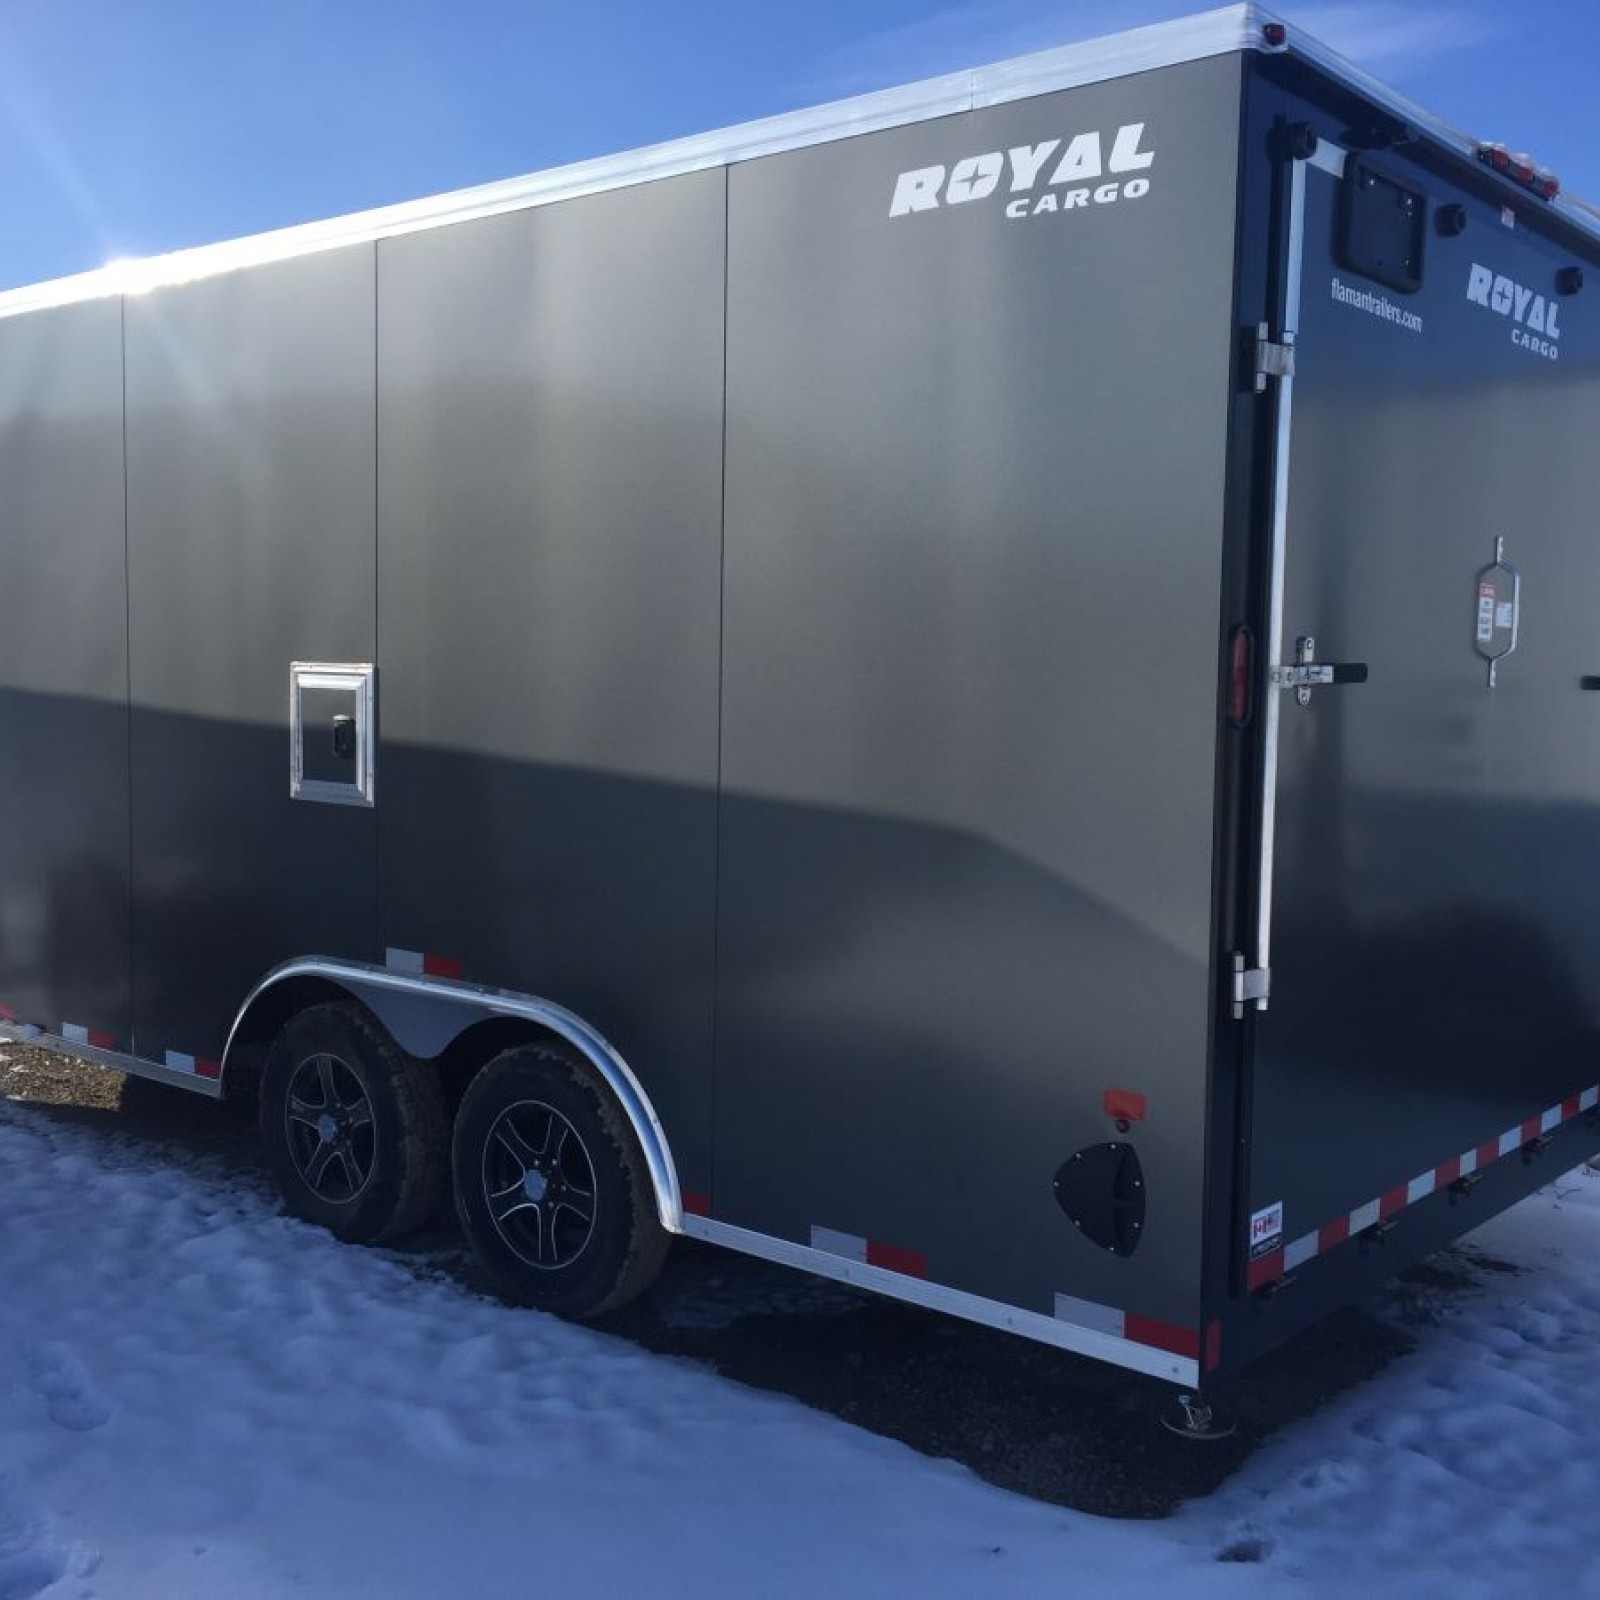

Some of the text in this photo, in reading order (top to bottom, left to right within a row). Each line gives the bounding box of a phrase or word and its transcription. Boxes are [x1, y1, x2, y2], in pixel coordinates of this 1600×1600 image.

[888, 122, 1155, 218] ROYAL
[1006, 178, 1150, 218] CARGO
[1466, 263, 1560, 340] ROYAL
[1511, 329, 1558, 360] CARGO
